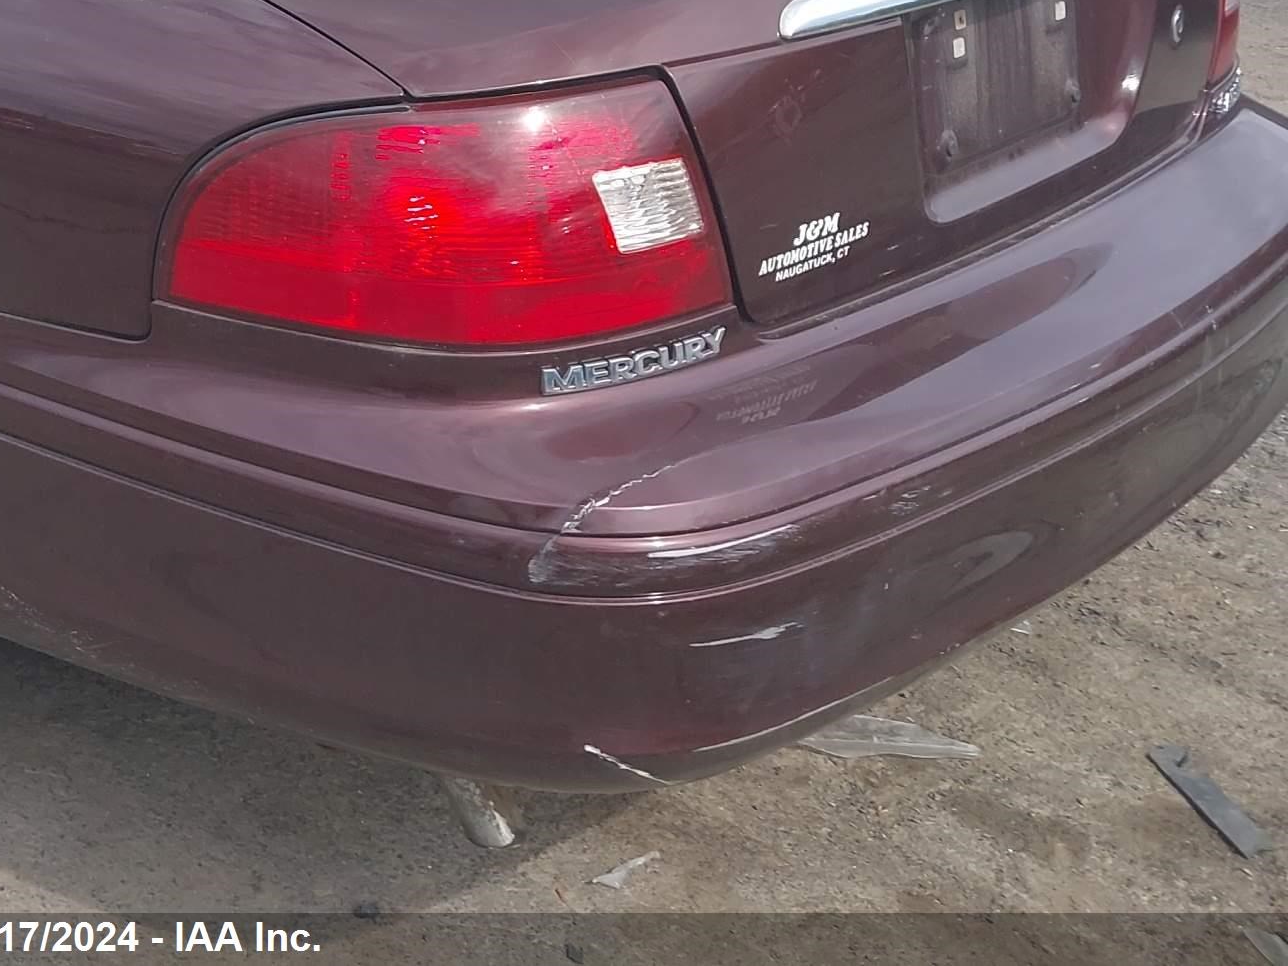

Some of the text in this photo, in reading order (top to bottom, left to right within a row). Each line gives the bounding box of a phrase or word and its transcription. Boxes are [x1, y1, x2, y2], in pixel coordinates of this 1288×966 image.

[758, 221, 870, 276] AUTOMOTIVE SALES
[793, 212, 840, 246] J&M
[775, 245, 851, 282] NAUGATUCK, CT
[541, 325, 726, 396] MERCURY
